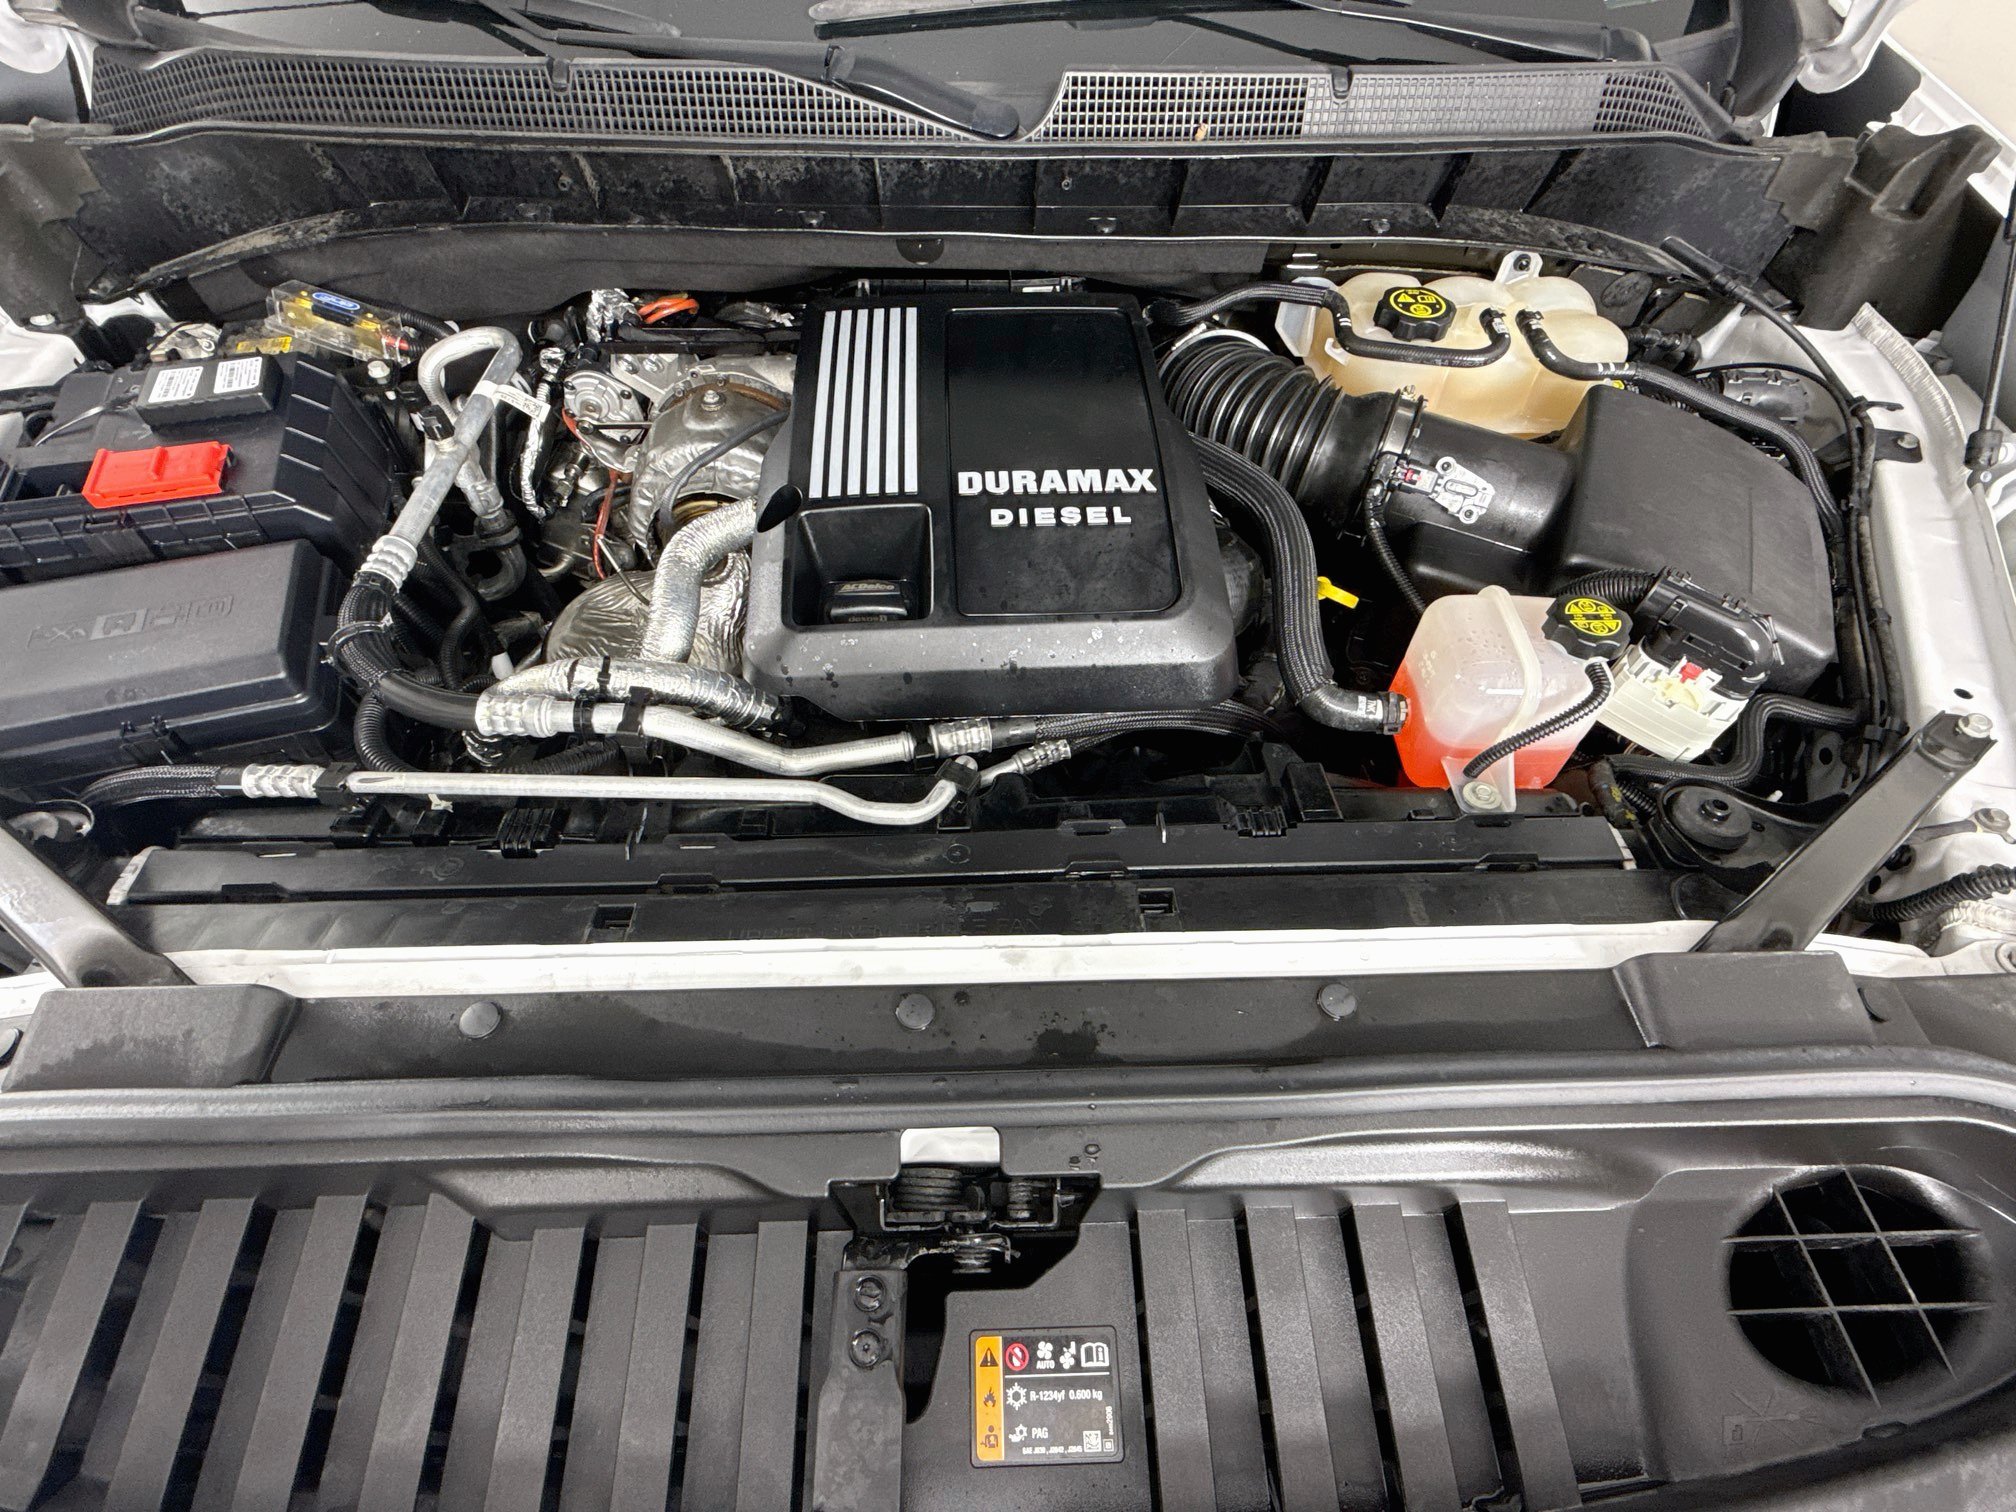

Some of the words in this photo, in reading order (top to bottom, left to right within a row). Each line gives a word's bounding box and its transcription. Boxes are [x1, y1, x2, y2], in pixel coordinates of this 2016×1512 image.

[957, 468, 1158, 496] DURAMAX
[990, 506, 1132, 527] DIESEL
[840, 583, 896, 592] ACDelco
[1036, 1360, 1055, 1369] AUTO
[1030, 1390, 1066, 1403] R-1234yf
[1069, 1389, 1092, 1400] 0.600
[1092, 1389, 1103, 1401] kg
[1031, 1427, 1049, 1439] PAG
